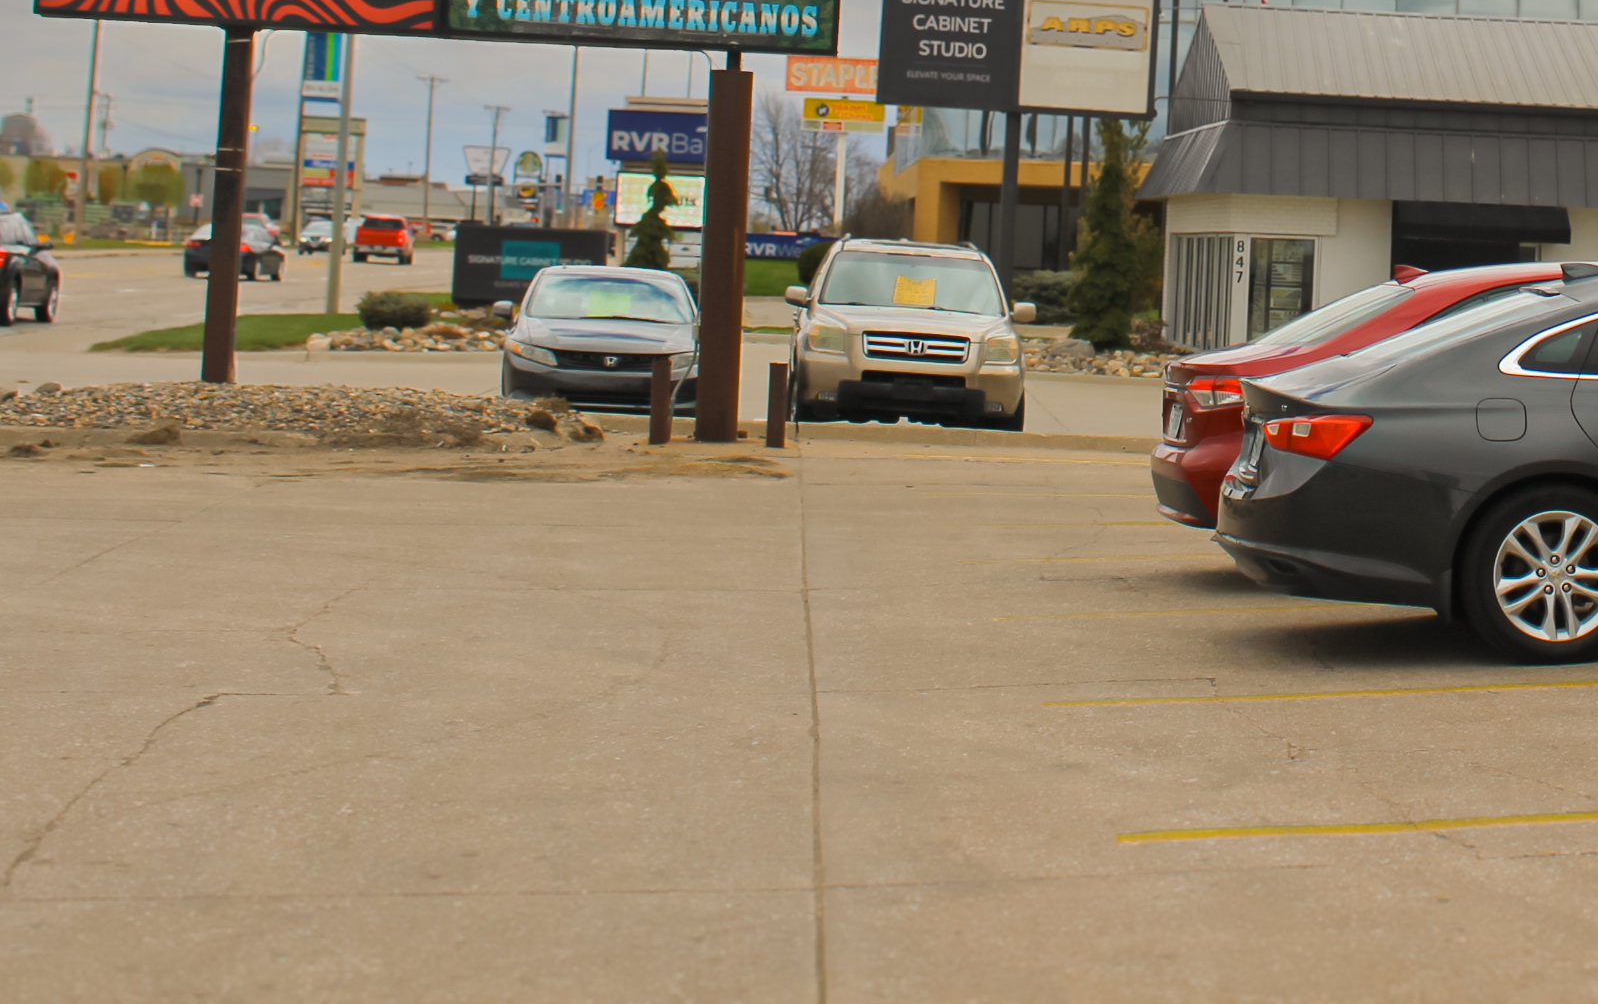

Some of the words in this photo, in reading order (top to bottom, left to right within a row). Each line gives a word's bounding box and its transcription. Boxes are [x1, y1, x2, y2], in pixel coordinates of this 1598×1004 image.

[912, 13, 993, 34] CABINET
[1040, 15, 1138, 37] ARPS
[918, 39, 988, 60] STUDIO
[790, 61, 879, 90] STAPLE
[906, 69, 939, 81] ELEVATE
[940, 71, 965, 82] YOUR
[966, 72, 991, 84] SPACE
[611, 129, 704, 155] RVRBa
[467, 254, 518, 266] SIGNATURE
[519, 256, 557, 267] CABINET
